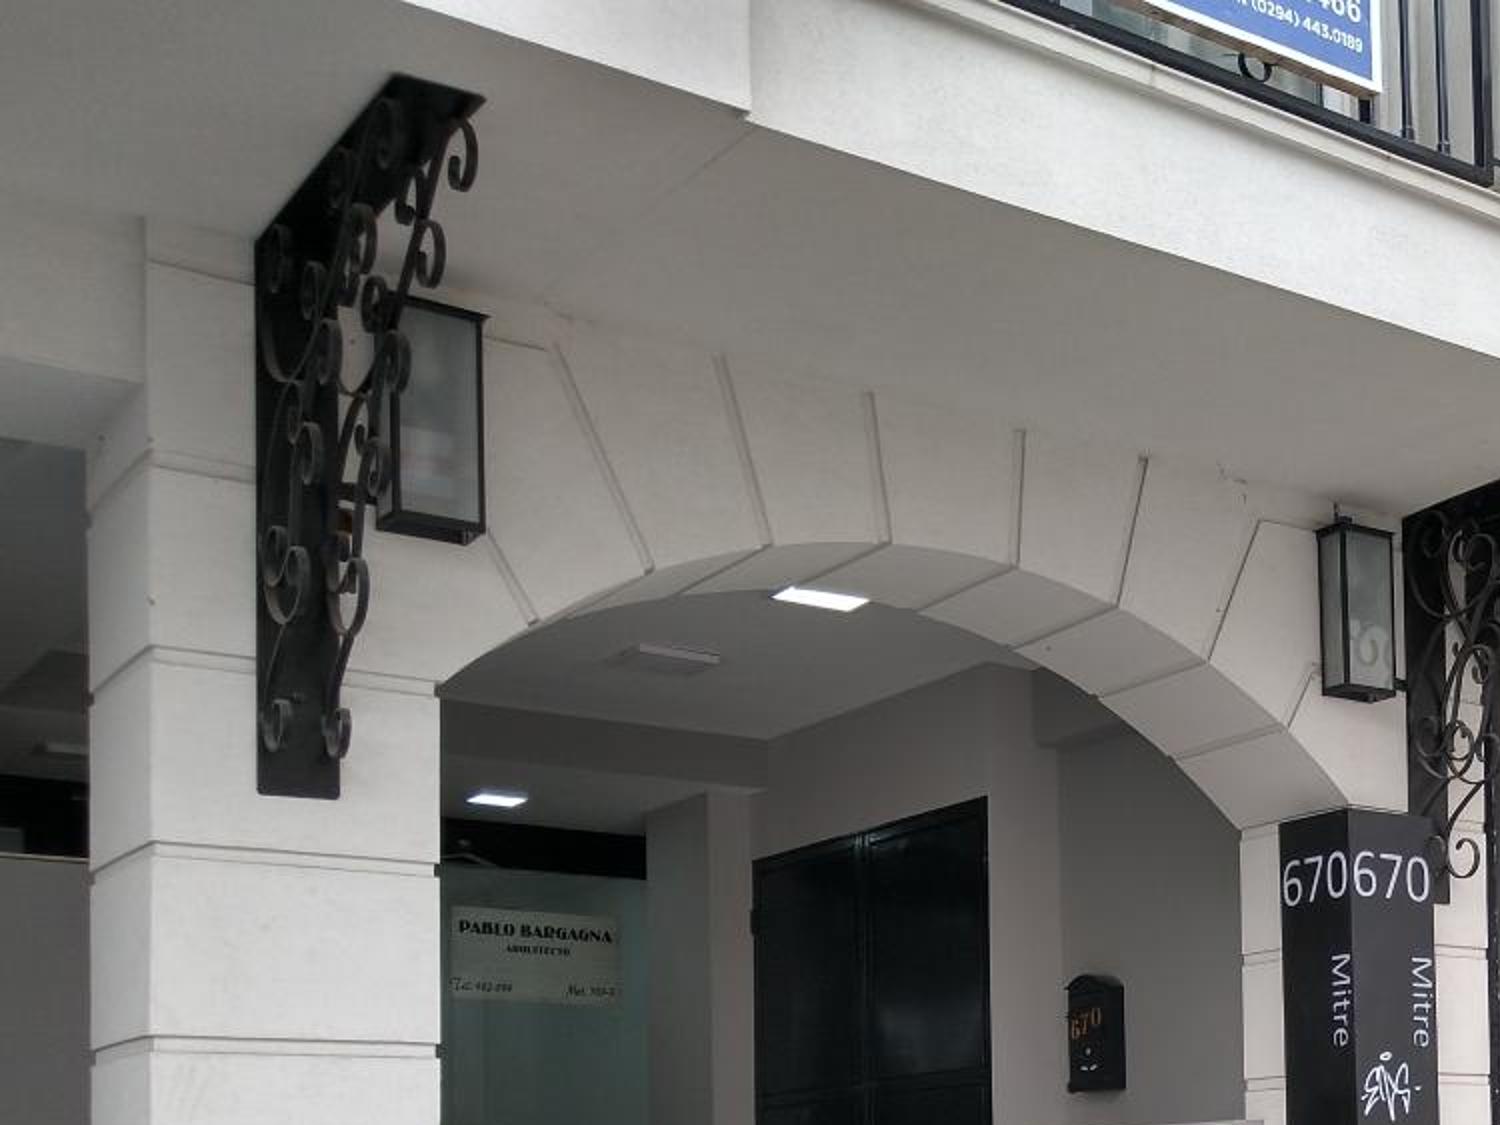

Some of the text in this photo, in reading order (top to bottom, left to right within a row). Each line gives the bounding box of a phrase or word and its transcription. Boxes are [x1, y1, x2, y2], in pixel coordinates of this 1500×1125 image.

[1251, 1, 1364, 53] (0294) 443.0189
[1282, 851, 1348, 907] 670
[1353, 850, 1431, 902] 670
[458, 919, 614, 944] PABLO BARGAGNA
[1071, 1007, 1102, 1040] 670
[1331, 953, 1352, 1047] Mitre
[1411, 956, 1434, 1048] Mitre
